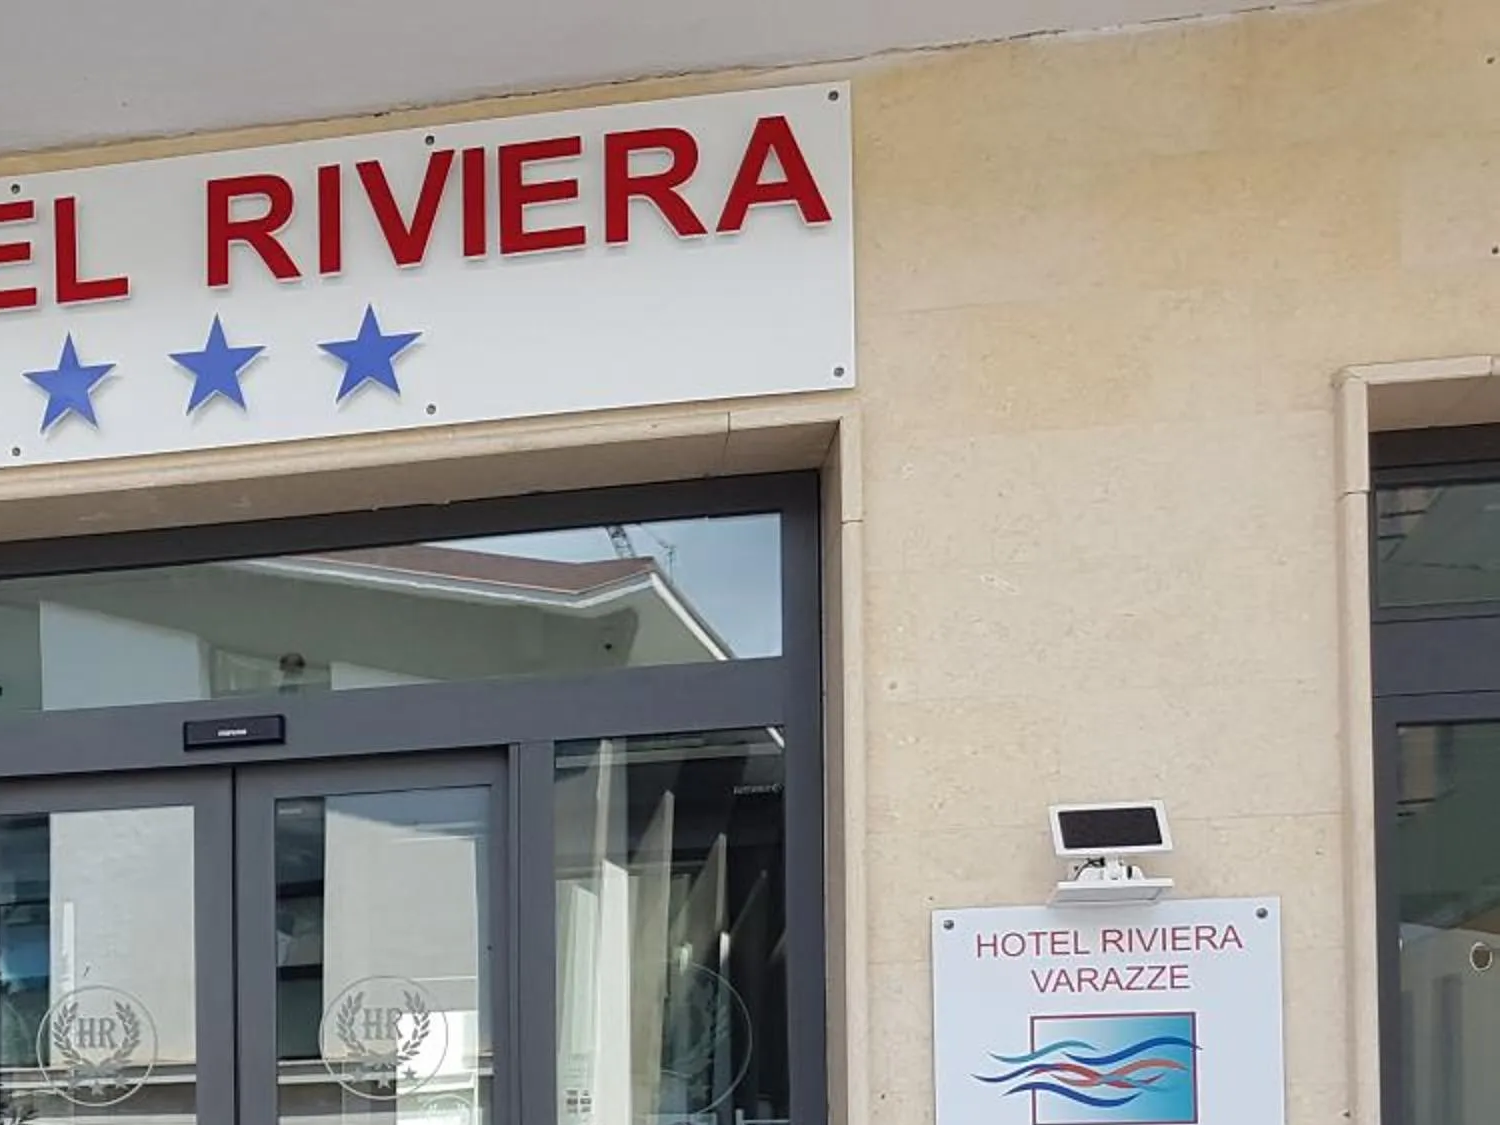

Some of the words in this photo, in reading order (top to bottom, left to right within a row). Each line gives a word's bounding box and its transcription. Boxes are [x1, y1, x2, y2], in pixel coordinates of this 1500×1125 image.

[206, 116, 831, 286] RIVIERA
[976, 929, 1091, 958] HOTEL
[1101, 924, 1243, 954] RIVIERA
[1030, 964, 1191, 994] VARAZZE
[77, 1018, 117, 1048] HR
[363, 1008, 403, 1040] HR
